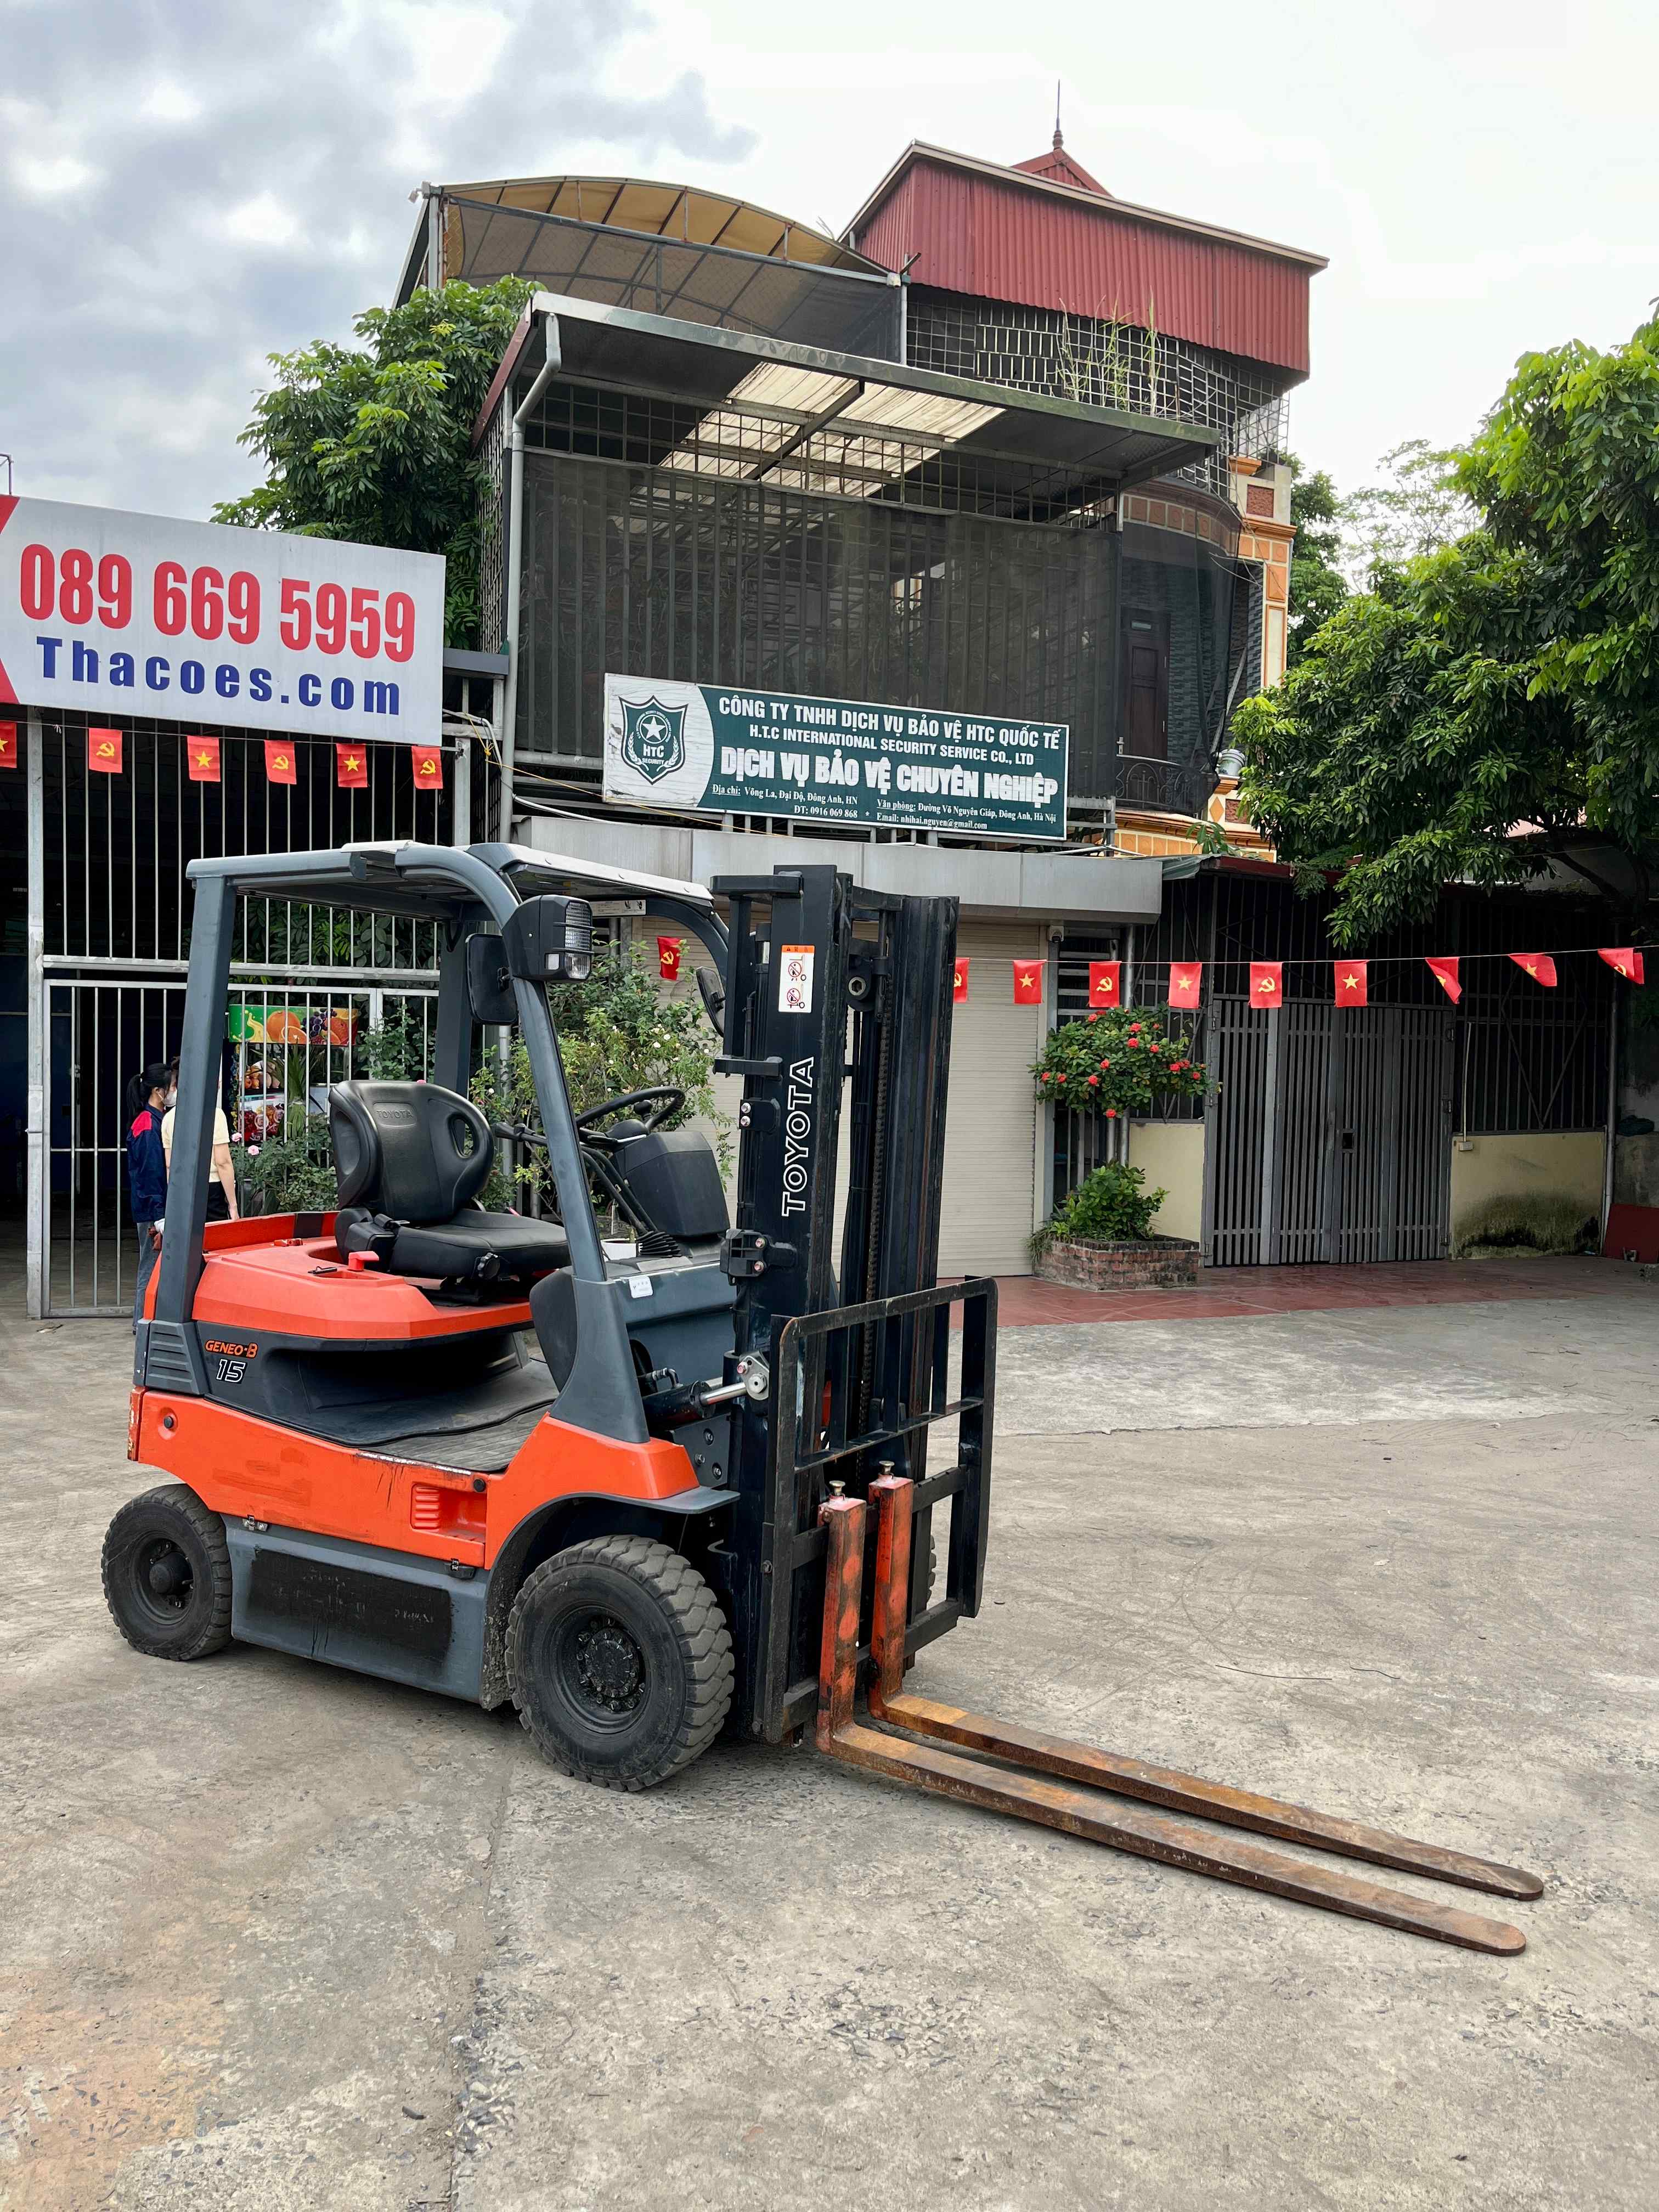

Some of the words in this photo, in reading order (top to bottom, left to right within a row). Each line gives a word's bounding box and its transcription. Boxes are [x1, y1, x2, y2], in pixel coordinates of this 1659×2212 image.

[20, 544, 132, 629] 089
[154, 561, 261, 645] 669
[280, 578, 415, 662] 5959
[36, 636, 400, 715] Thacoes.com
[719, 695, 765, 719] CÔNG
[770, 702, 789, 721] TY
[793, 704, 837, 726] TNHH
[841, 709, 878, 732] DỊCH
[883, 714, 904, 737] VỤ
[908, 714, 939, 737] BẢO
[944, 719, 962, 743] VỆ
[966, 724, 995, 743] HTC
[999, 725, 1039, 747] QUỐC
[1043, 729, 1062, 749] TẾ
[642, 743, 665, 758] HTC
[749, 724, 780, 740] H.T.C
[783, 728, 877, 750] INTERNATIONAL
[880, 738, 936, 756] SECURITY
[940, 744, 988, 761] SERVICE
[990, 751, 1012, 765] CO.,
[1015, 753, 1034, 765] LTD
[721, 746, 775, 782] DỊCH
[780, 752, 810, 787] VỤ
[815, 748, 860, 786] BẢO
[864, 757, 891, 795] VỆ
[896, 764, 979, 798] CHUYÊN
[984, 772, 1059, 809] NGHIỆP
[712, 784, 725, 795] Địa
[744, 787, 764, 799] Võng
[765, 789, 777, 799] La,
[779, 790, 792, 801] Đại
[793, 791, 806, 802] Độ,
[807, 792, 826, 804] Đông
[827, 794, 844, 805] Anh,
[845, 795, 858, 804] HN
[794, 805, 808, 815] ĐT:
[810, 806, 828, 816] 0916
[830, 808, 843, 817] 069
[844, 809, 858, 818] 868
[877, 799, 891, 808] Văn
[893, 800, 916, 812] phòng:
[953, 805, 978, 817] Nguyên
[979, 808, 997, 819] Giáp,
[998, 809, 1016, 821] Đông
[1017, 811, 1032, 821] Anh,
[1034, 812, 1043, 821] Hà
[1045, 813, 1056, 824] Nội
[877, 812, 899, 822] Email:
[900, 815, 988, 829] nhihai.nguyen@gmail.com
[376, 1109, 413, 1119] TOYOTA
[781, 1057, 815, 1217] TOYOTA
[205, 1340, 258, 1358] GENEO-B
[216, 1358, 246, 1383] 15
